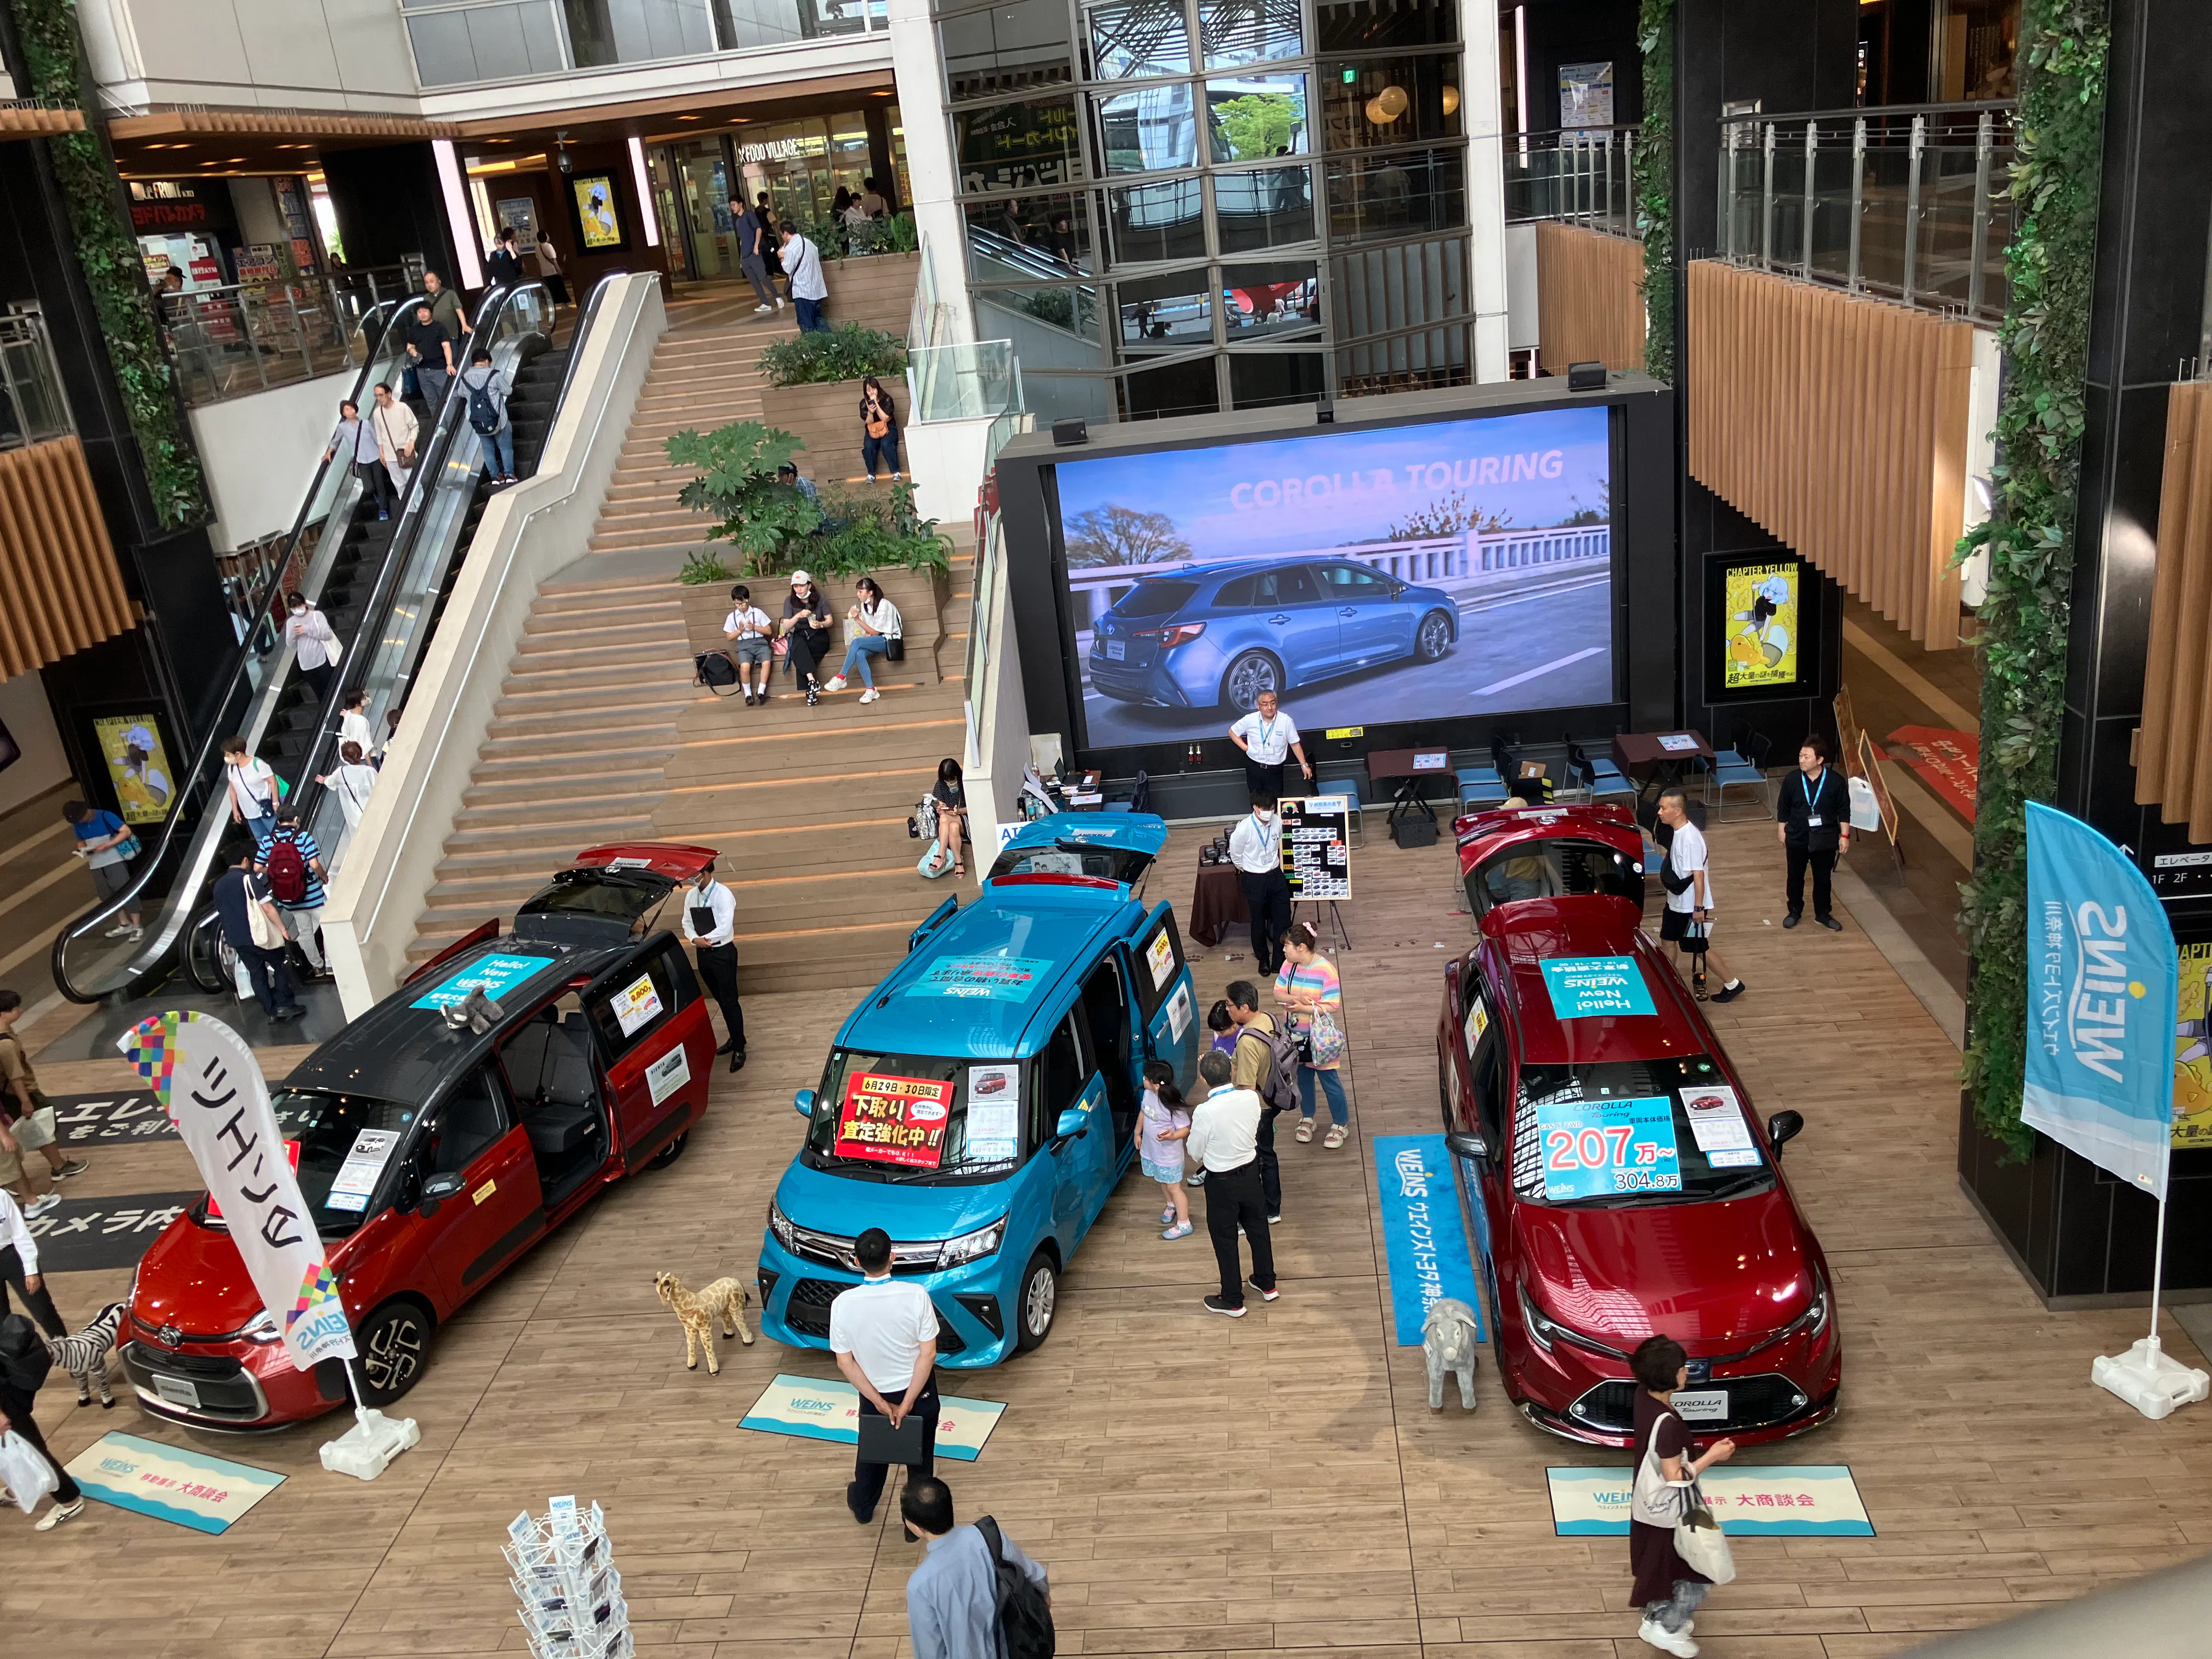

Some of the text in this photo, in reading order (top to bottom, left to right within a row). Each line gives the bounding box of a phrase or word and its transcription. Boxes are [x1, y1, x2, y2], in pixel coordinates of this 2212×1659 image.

[745, 138, 798, 163] FOOD VILLAGE
[1230, 449, 1563, 510] COROLLA TOURING
[1727, 562, 1798, 577] CHAPTER YELLOW
[2159, 855, 2212, 865] エレベータ
[2152, 873, 2188, 884] 1F 2F
[2178, 943, 2212, 962] APT
[488, 960, 531, 969] Hello!
[479, 968, 511, 977] New
[456, 978, 505, 989] WEINS
[1564, 978, 1629, 988] WEINS
[943, 988, 990, 996] WEINS
[1579, 990, 1621, 998] New
[1577, 1000, 1631, 1010] Hello!
[865, 1081, 940, 1097] 6月29日・30日限定
[55, 1098, 166, 1122] エレ
[853, 1094, 905, 1122] 下取り
[1573, 1101, 1633, 1111] COROLLA
[1629, 1115, 1671, 1124] 車両本体価格
[842, 1121, 941, 1147] 査定強化中!!
[1397, 1149, 1428, 1198] WEINS
[1615, 1172, 1678, 1190] 304.8万
[1548, 1183, 1575, 1194] WEINS
[791, 1398, 836, 1410] WEINS
[100, 1457, 139, 1474] WEINS
[140, 1473, 178, 1488] 移動展示
[176, 1482, 228, 1503] 大商談会
[1593, 1492, 1633, 1503] WEIN
[1736, 1494, 1815, 1507] 大商談会
